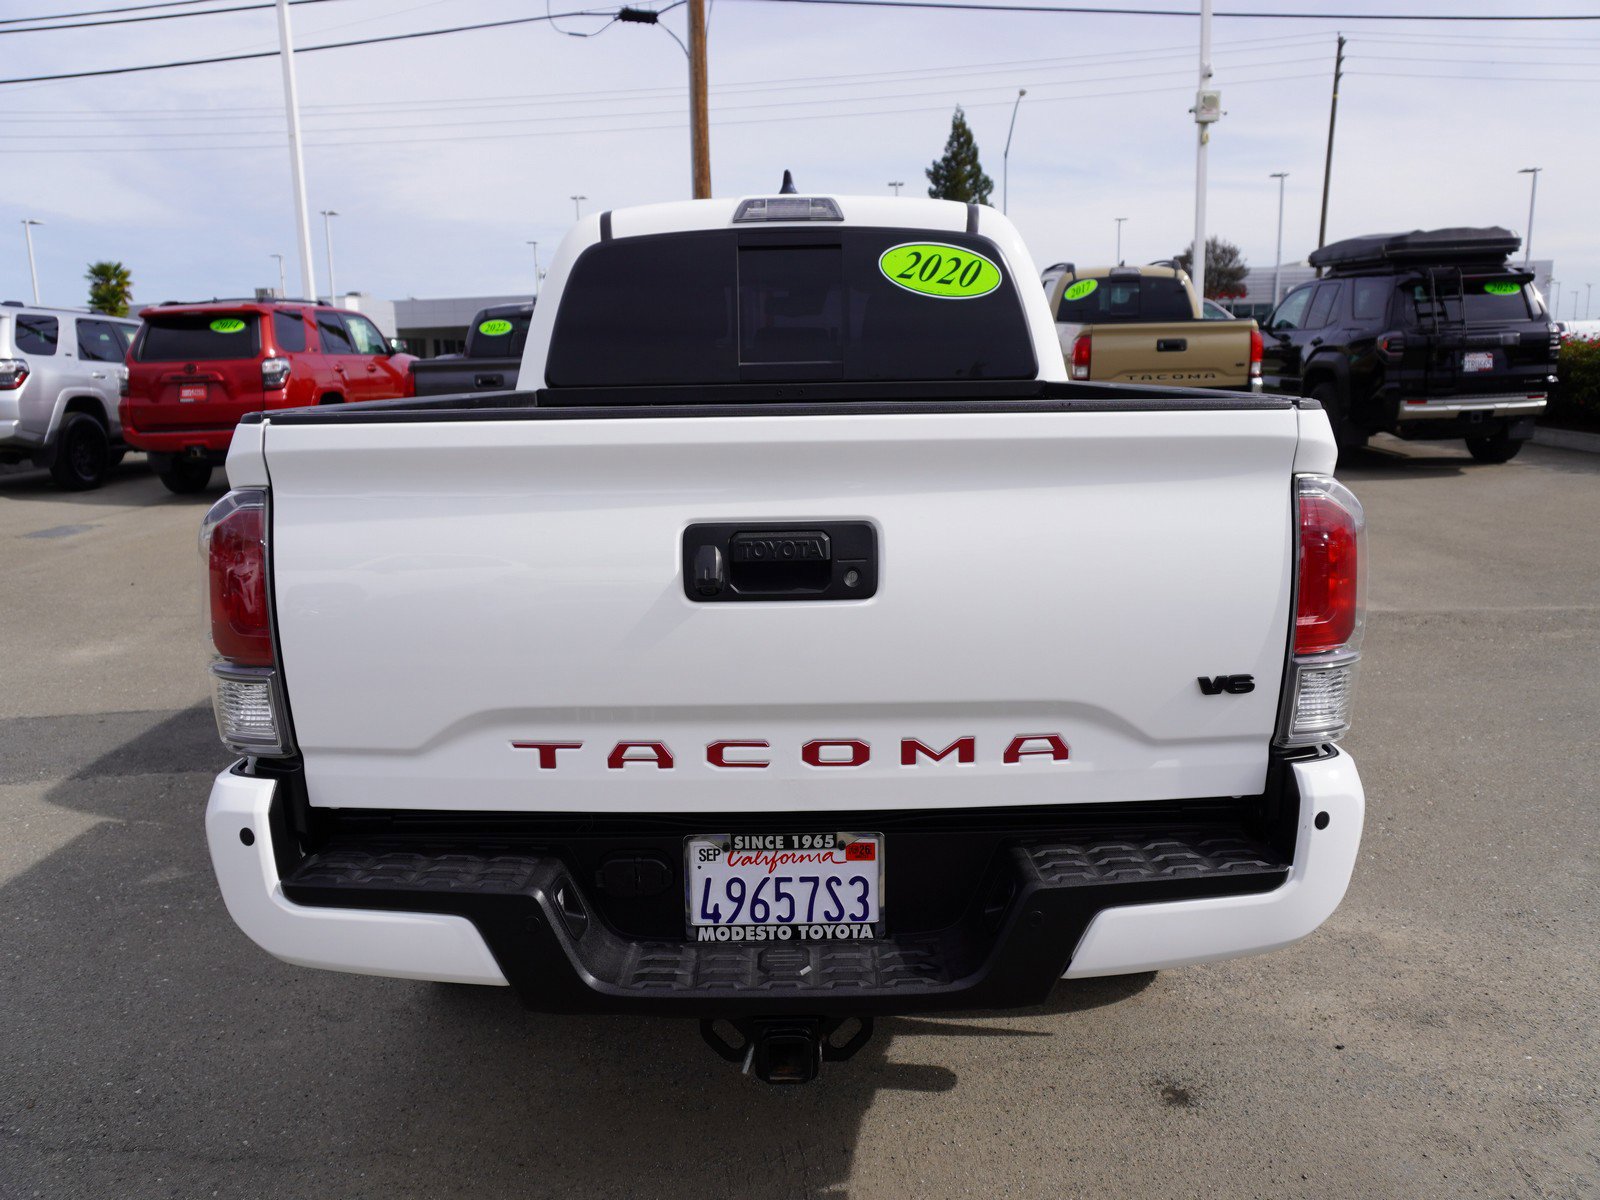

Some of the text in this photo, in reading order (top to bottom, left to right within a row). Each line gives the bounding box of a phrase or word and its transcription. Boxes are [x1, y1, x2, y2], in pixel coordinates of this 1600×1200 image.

[896, 251, 982, 288] 2020
[1070, 281, 1091, 298] 2017
[484, 322, 506, 332] 2022
[1125, 373, 1216, 381] TACOMA
[737, 540, 825, 559] TOYOTA
[1197, 673, 1256, 696] V6
[511, 733, 1070, 770] TACOMA
[734, 834, 835, 850] SINCE 1965
[699, 848, 721, 862] SEP
[727, 850, 847, 874] California
[701, 876, 870, 924] 49657S3
[698, 924, 874, 942] MODESTO TOYOTA
